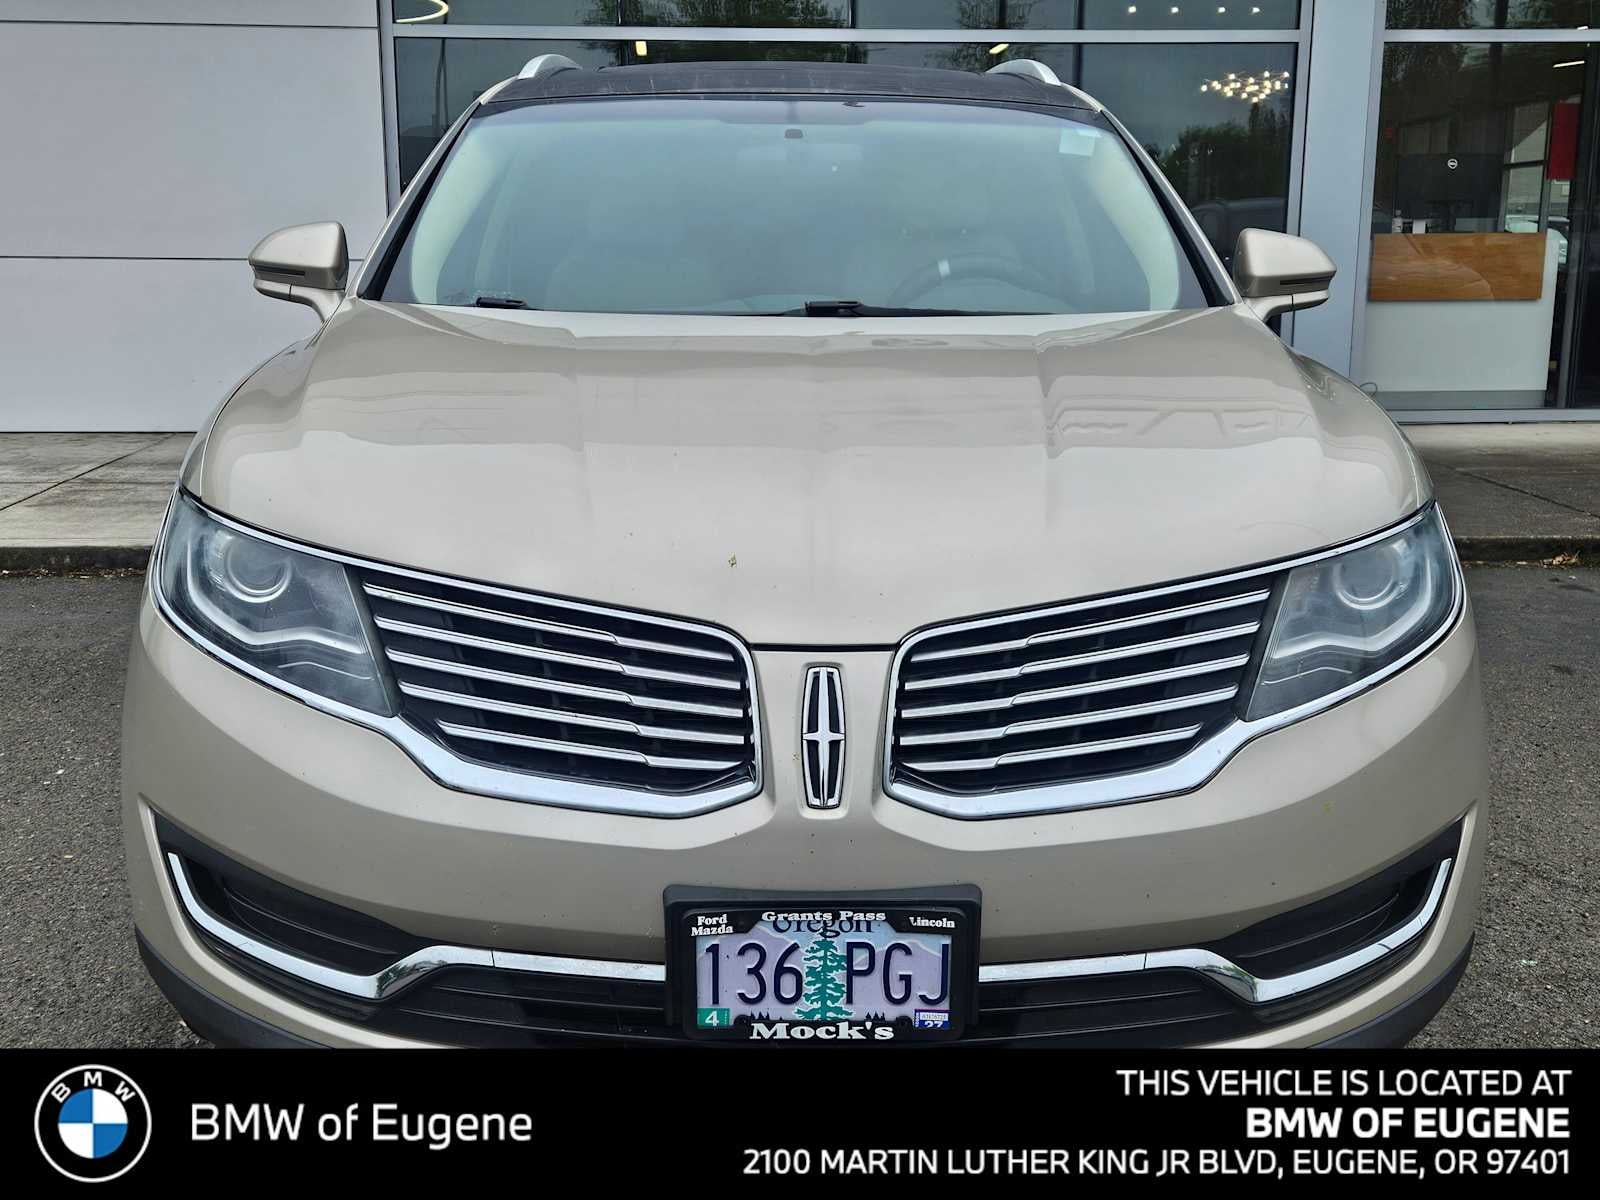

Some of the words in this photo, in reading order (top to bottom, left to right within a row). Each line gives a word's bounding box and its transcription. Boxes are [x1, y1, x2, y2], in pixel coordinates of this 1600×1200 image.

[697, 913, 728, 926] Ford
[761, 911, 832, 922] Grants
[839, 910, 886, 921] Pass
[909, 916, 956, 928] Lincoln
[690, 924, 734, 937] Mazda
[772, 919, 873, 938] Oregon
[705, 942, 802, 1005] 136
[845, 941, 949, 1005] PGJ
[704, 1010, 720, 1027] 4
[924, 1020, 944, 1028] 27
[749, 1021, 894, 1039] Mock's
